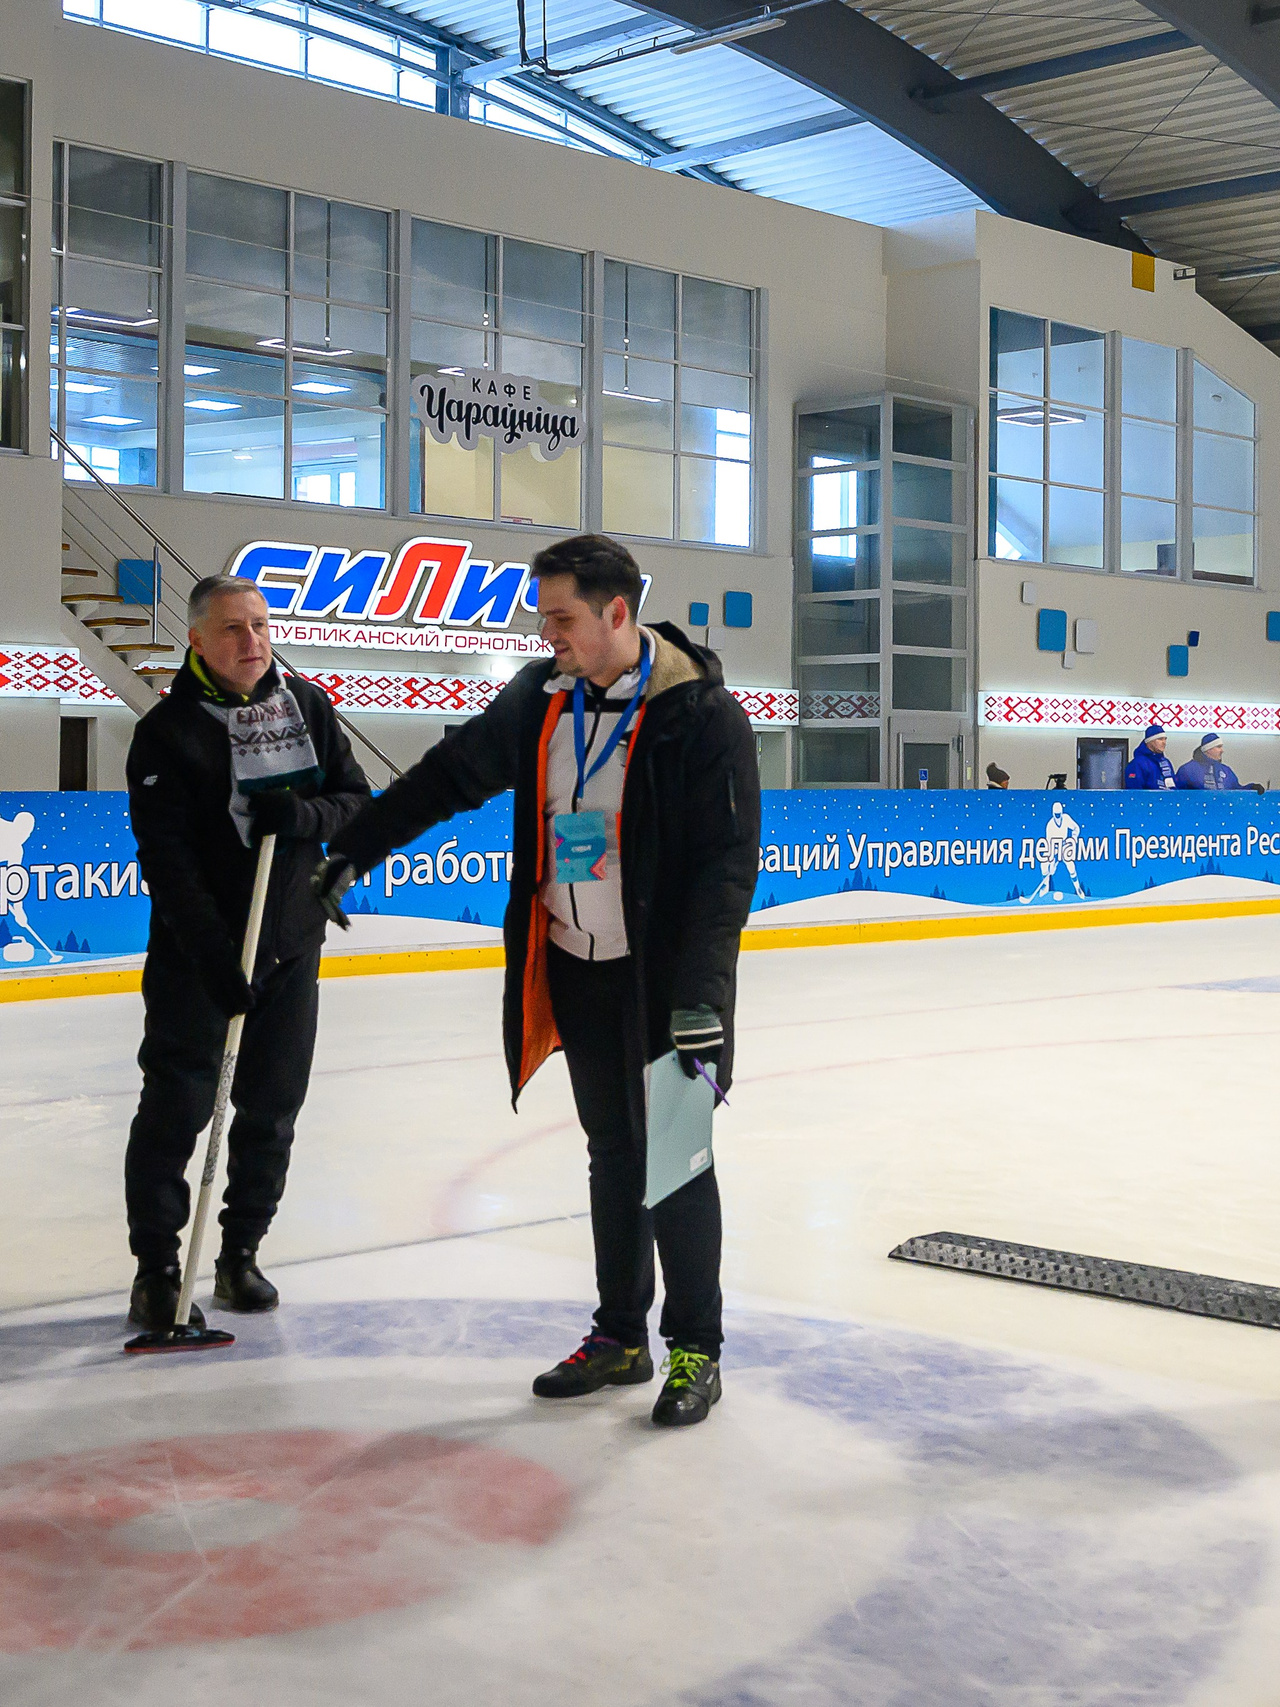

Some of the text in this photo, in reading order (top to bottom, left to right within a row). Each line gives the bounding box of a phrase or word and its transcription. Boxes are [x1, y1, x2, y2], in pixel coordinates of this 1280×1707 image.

[419, 384, 579, 451] Чараўніца
[471, 376, 531, 401] КАФЕ
[232, 537, 652, 628] СИЛИ
[269, 624, 552, 653] ПУБЛИКАНСКИЙ ГОРНОЛЫЖ
[0, 861, 150, 915] ртаки
[846, 832, 1013, 878] Управления
[1018, 835, 1109, 870] делами
[1114, 828, 1241, 868] Президента
